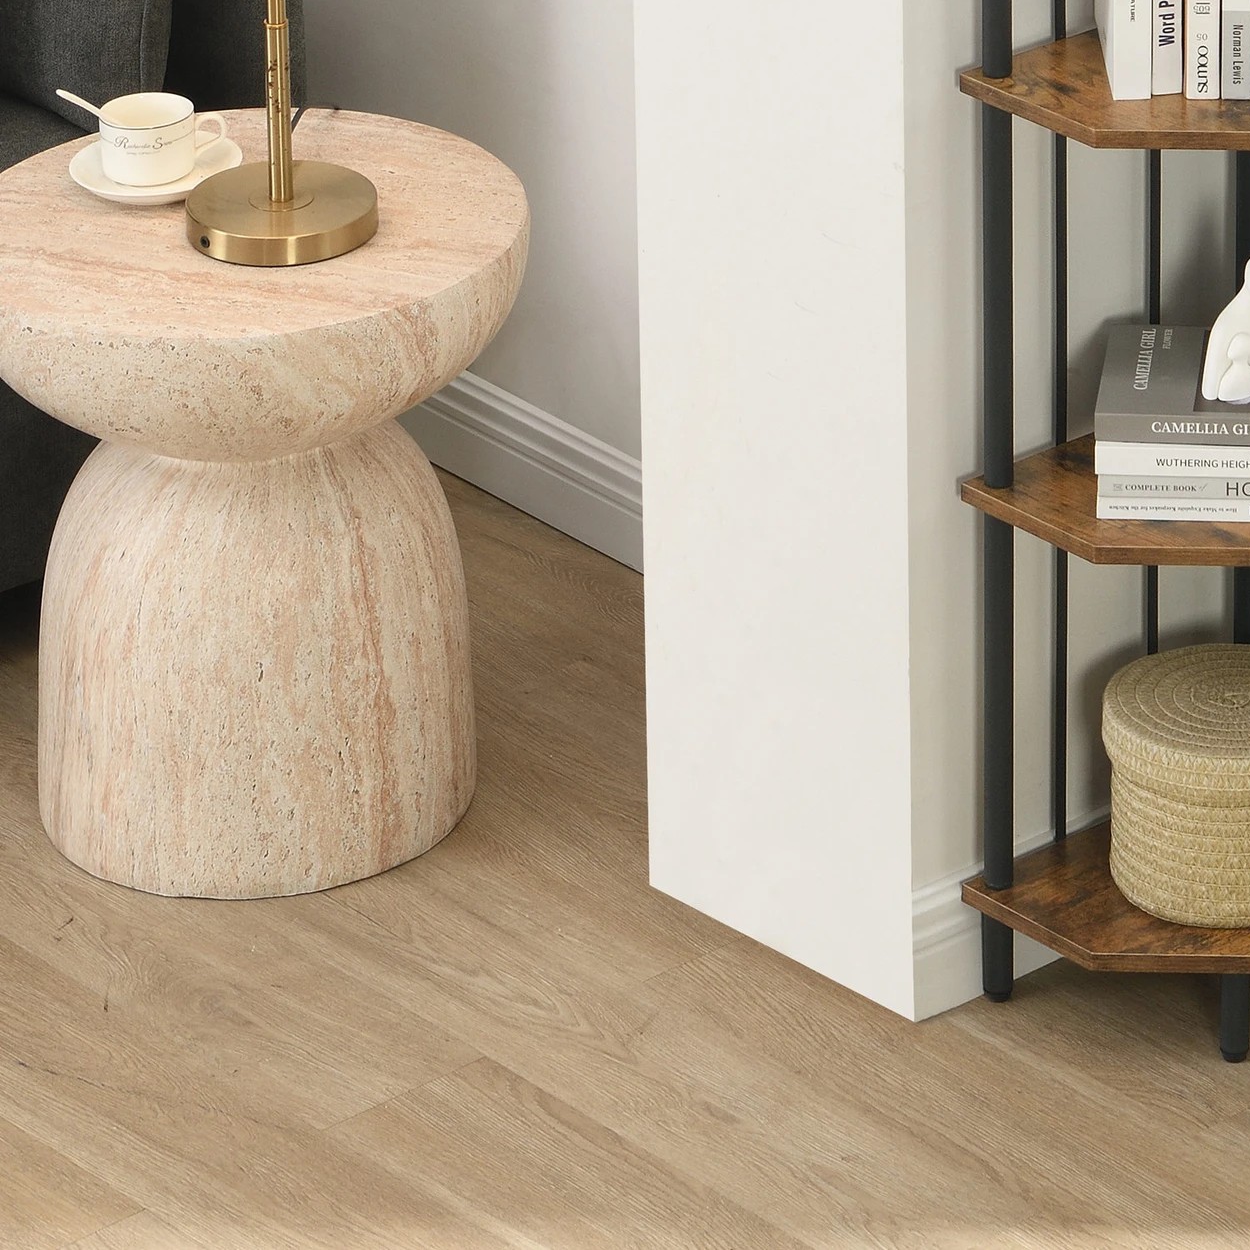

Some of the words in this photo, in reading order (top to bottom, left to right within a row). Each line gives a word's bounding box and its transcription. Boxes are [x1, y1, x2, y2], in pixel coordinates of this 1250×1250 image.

[1158, 12, 1176, 47] Word
[1232, 24, 1244, 58] Norman
[1232, 61, 1243, 85] Lewis
[1140, 328, 1157, 349] GIRL
[1162, 329, 1173, 350] FLOWER
[1133, 350, 1154, 390] CAMELLIA
[1151, 421, 1230, 435] CAMELLIA
[1155, 458, 1219, 469] WUTHERING
[1124, 484, 1170, 492] COMPLETE
